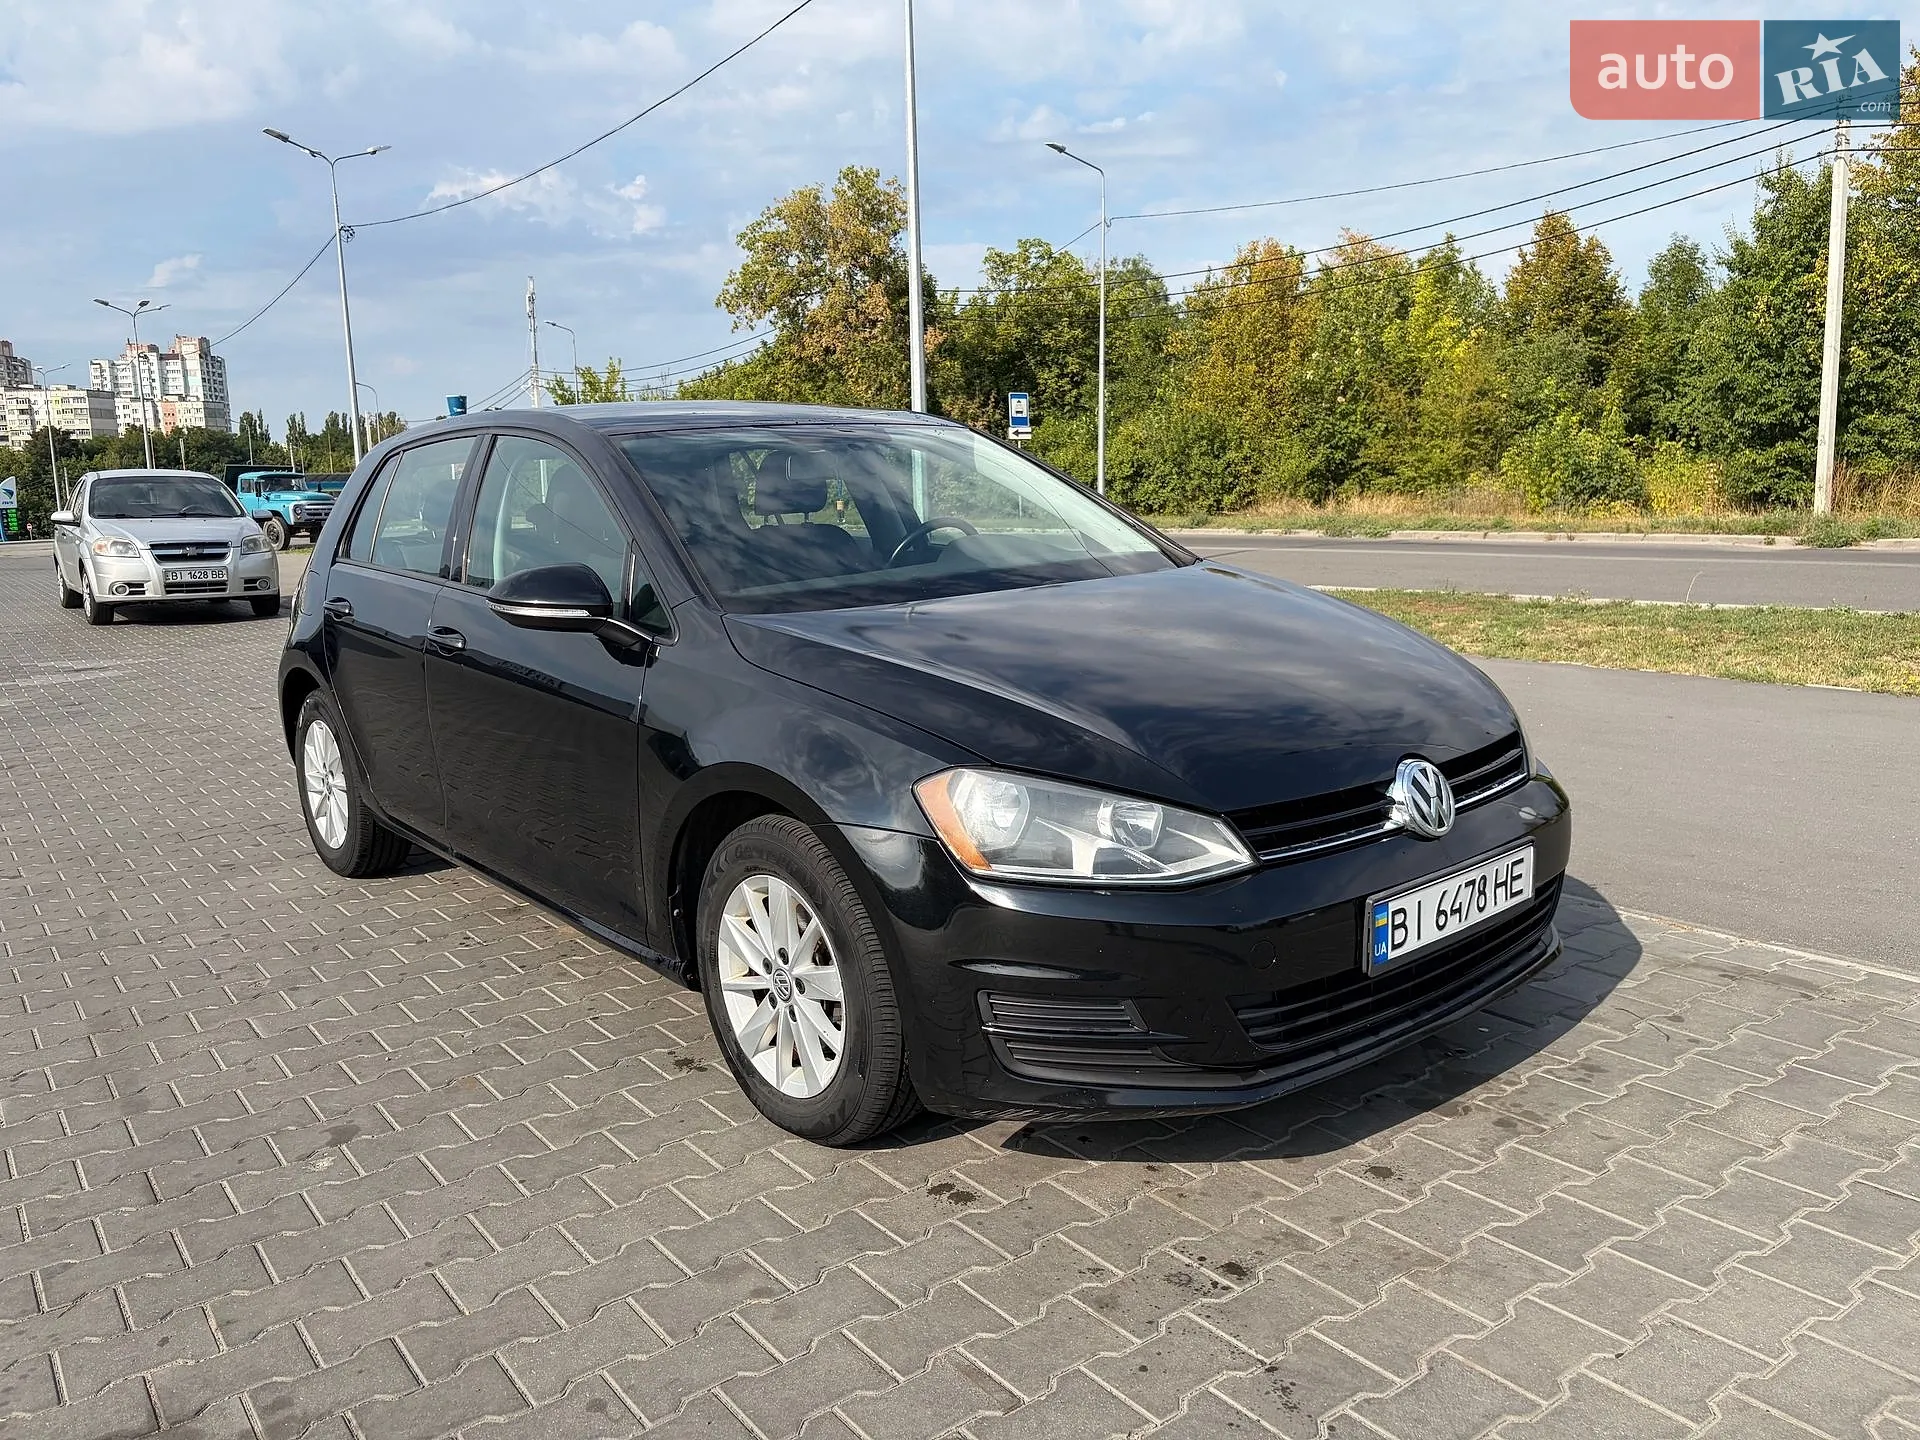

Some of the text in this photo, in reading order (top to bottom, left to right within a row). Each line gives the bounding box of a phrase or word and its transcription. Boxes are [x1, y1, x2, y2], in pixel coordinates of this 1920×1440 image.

[171, 570, 224, 581] BI 1628 BB
[1391, 857, 1525, 951] BI 6478 HE
[1374, 943, 1387, 957] UA
